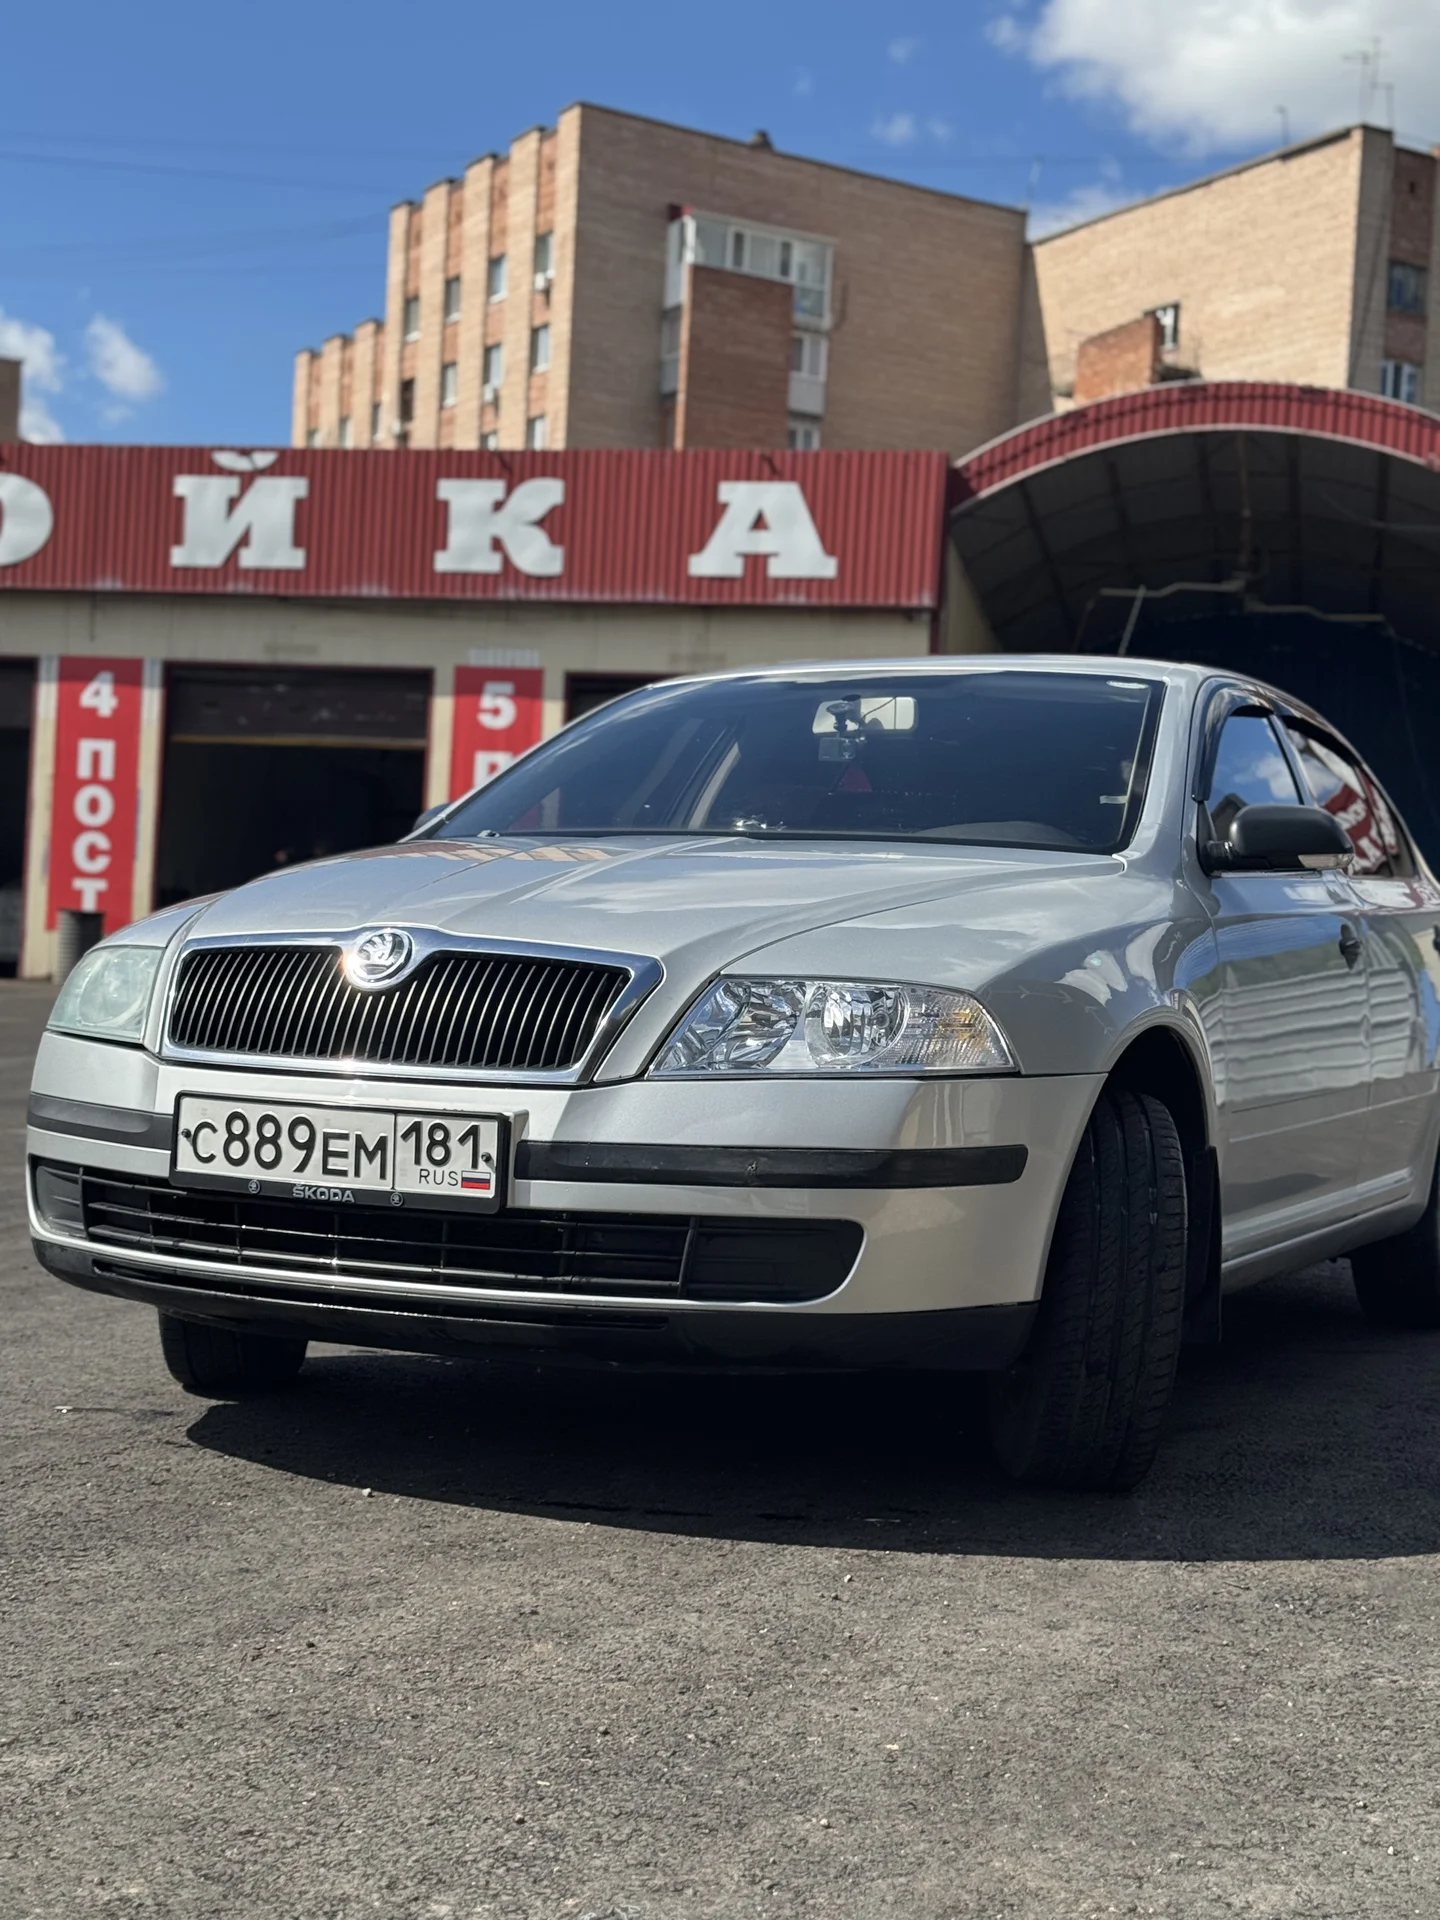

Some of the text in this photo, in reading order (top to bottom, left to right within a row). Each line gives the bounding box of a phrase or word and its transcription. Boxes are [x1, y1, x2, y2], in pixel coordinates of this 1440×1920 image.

[476, 681, 517, 730] 5
[72, 671, 118, 912] 4 ПОСТ
[400, 1120, 480, 1169] 181
[418, 1168, 459, 1187] RUS
